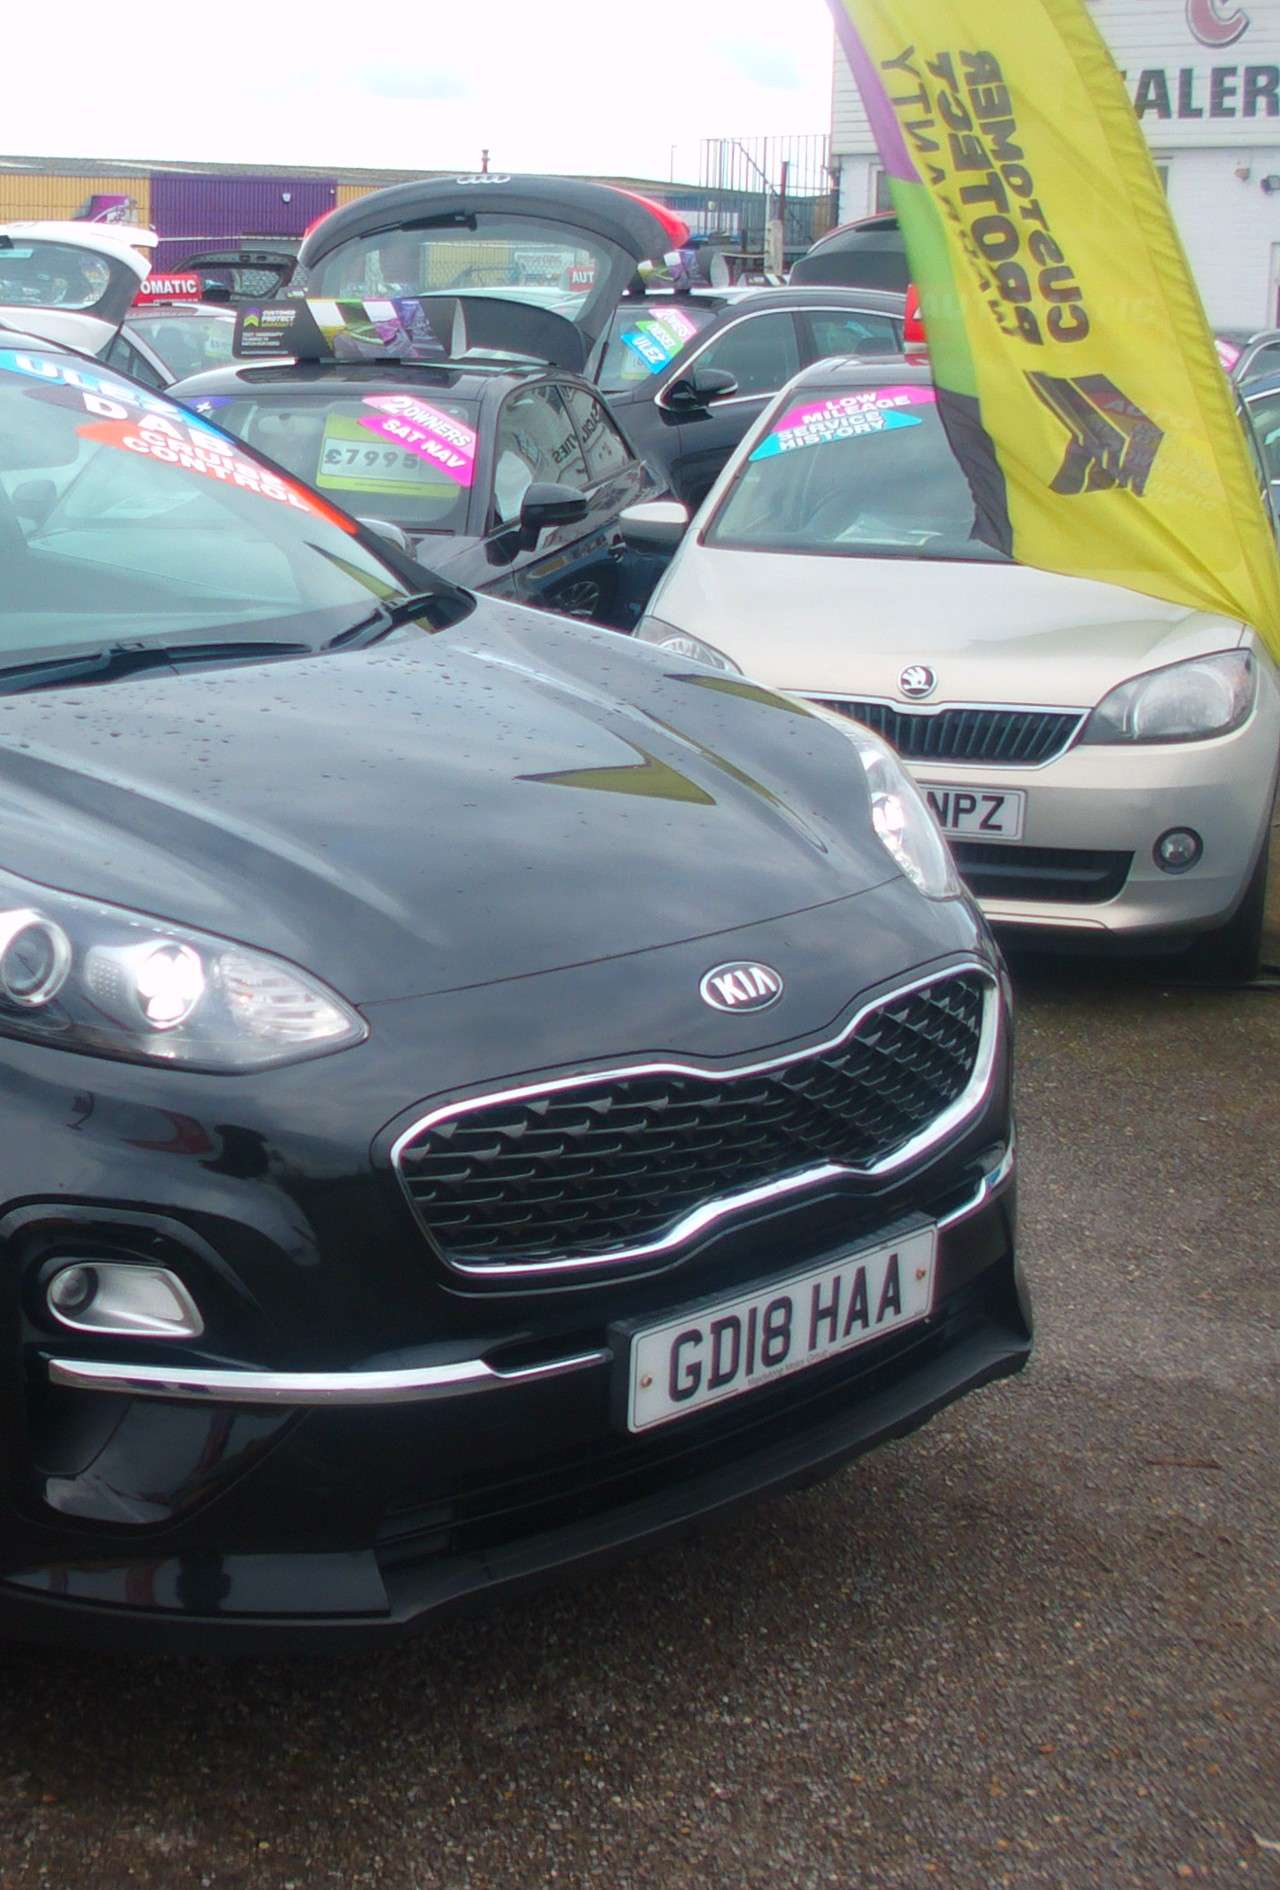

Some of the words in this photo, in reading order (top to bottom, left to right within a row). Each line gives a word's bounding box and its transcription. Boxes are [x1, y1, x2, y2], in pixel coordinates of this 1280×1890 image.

[1120, 65, 1280, 119] ALER
[140, 279, 198, 295] OMATIC
[801, 395, 912, 424] MILEAGE
[825, 392, 878, 411] LOW
[82, 391, 234, 457] DAB
[381, 418, 426, 443] SAT
[421, 439, 466, 468] NAV
[402, 404, 471, 448] OWNERS
[779, 411, 883, 440] SERVICE
[779, 419, 886, 451] HISTORY
[122, 436, 311, 512] CONTROL
[324, 448, 419, 470] £7995
[926, 791, 1005, 832] NPZ
[710, 966, 777, 1005] KIA
[668, 1294, 794, 1403] GD18
[808, 1252, 902, 1351] HAA
